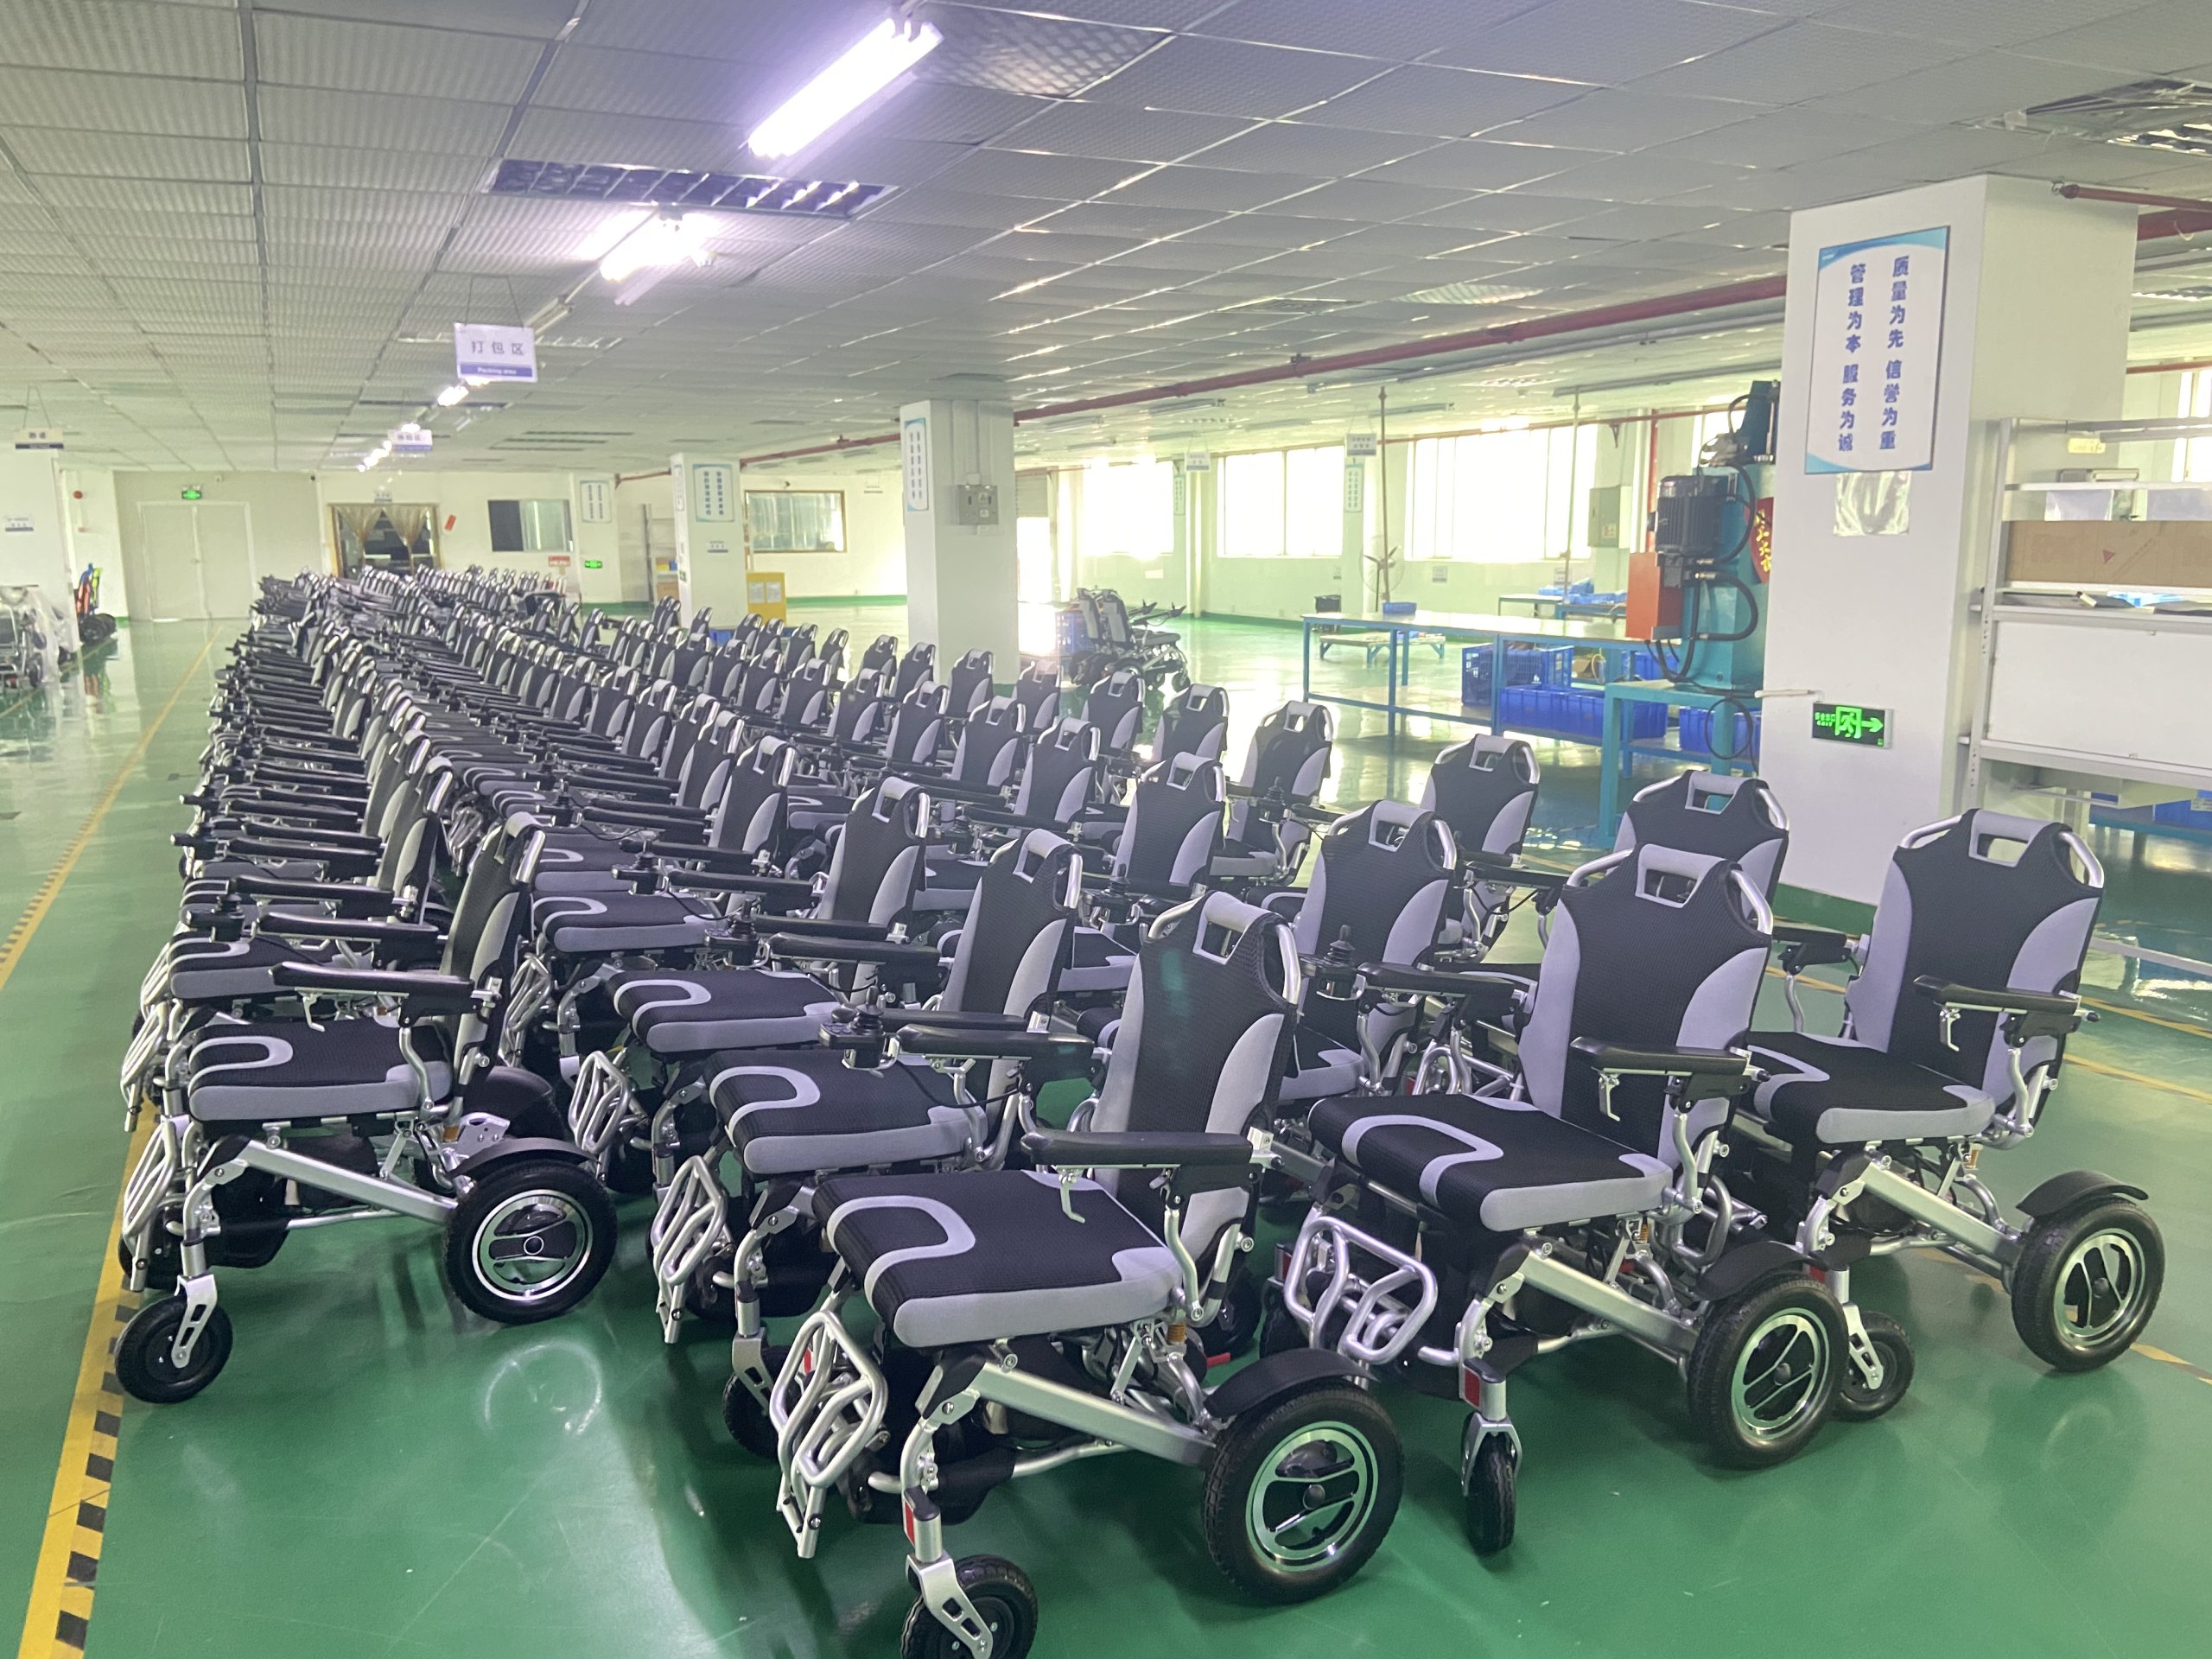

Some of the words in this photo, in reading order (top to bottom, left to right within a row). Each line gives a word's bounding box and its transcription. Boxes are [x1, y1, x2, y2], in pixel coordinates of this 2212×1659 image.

[470, 340, 524, 355] 打包区
[1846, 263, 1866, 353] 管理为本
[1887, 256, 1910, 349] 质量为先
[1838, 364, 1859, 452] 服务为诚
[1879, 359, 1903, 449] 信誉为重
